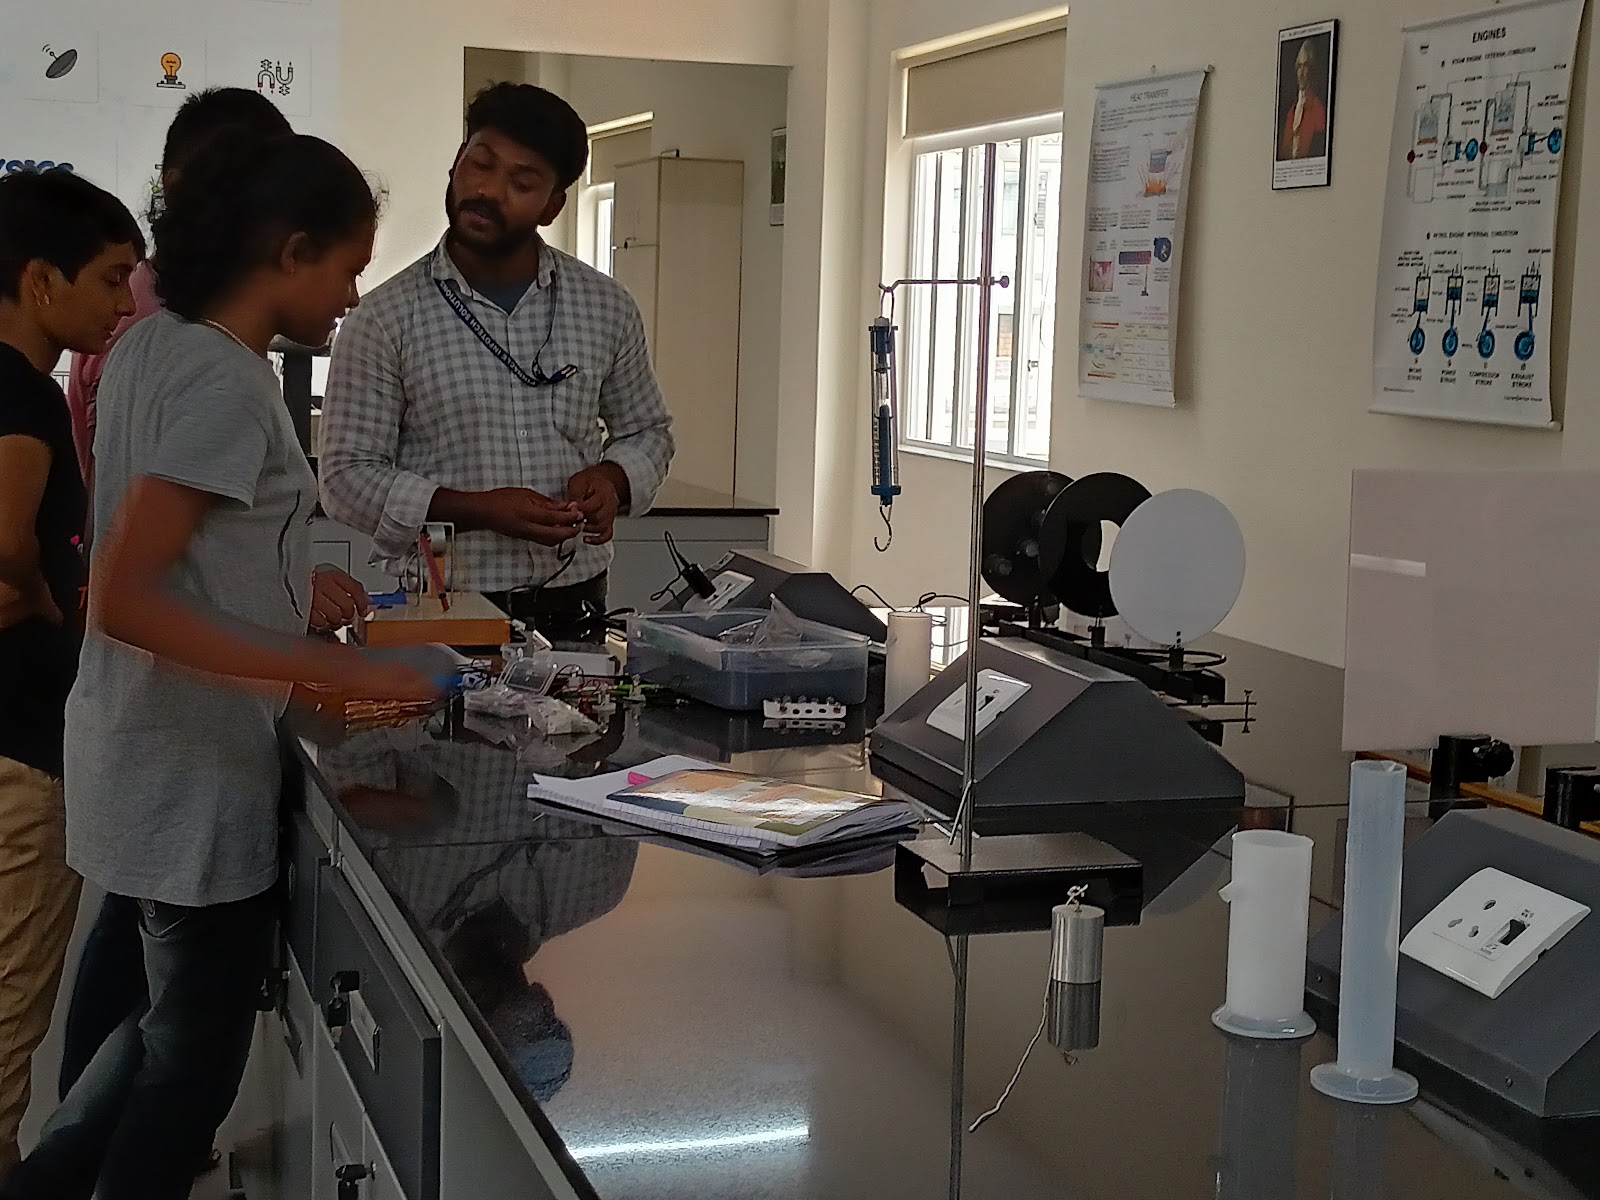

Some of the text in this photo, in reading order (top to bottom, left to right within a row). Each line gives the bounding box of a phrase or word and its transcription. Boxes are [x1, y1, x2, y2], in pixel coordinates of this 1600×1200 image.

[1472, 27, 1506, 43] ENGINES
[439, 280, 536, 386] PINNACLE INFOTECH SOLUTIONS
